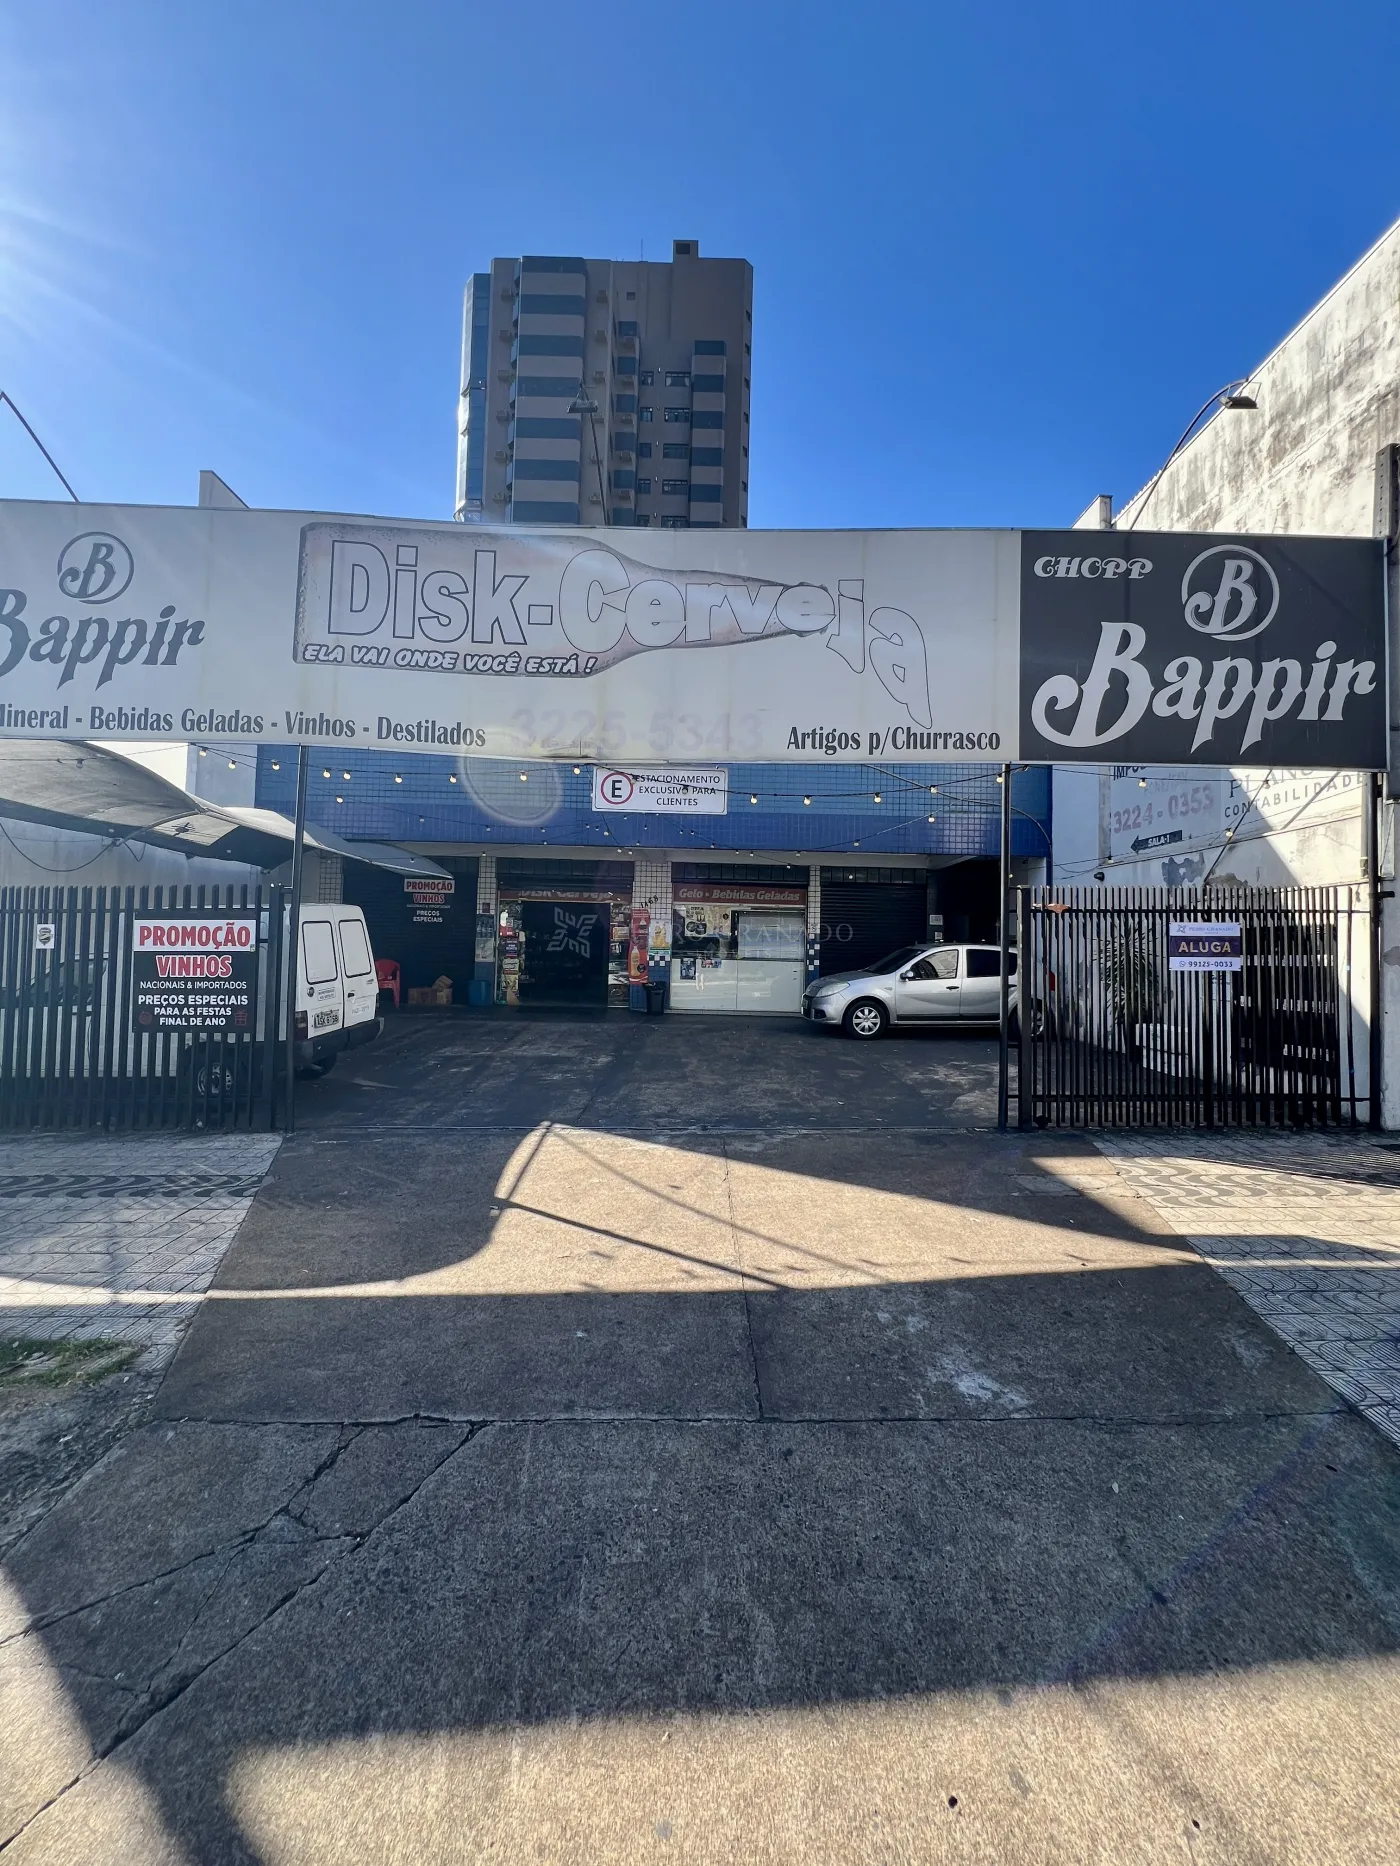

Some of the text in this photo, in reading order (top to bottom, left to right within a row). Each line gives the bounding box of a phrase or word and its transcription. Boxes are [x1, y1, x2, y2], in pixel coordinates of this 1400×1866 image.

[1033, 556, 1154, 580] CHOPP
[328, 539, 933, 729] Disk-Cerveja
[303, 644, 345, 663] ELA
[350, 646, 390, 665] VAI
[394, 648, 459, 669] ONDE
[463, 651, 522, 673] VOCÊ
[525, 653, 579, 675] ESTÁ
[1031, 621, 1376, 756] Bappir
[0, 703, 68, 729] ineral
[90, 706, 173, 732] Bebidas
[181, 708, 264, 733] Geladas
[285, 711, 356, 738] Vinhos
[377, 716, 486, 747] Destilados
[787, 726, 1000, 756] Artigos p/Churrasco
[635, 774, 721, 784] ESTACIONAMENTO
[611, 780, 622, 798] E
[692, 787, 716, 795] PARA
[656, 798, 698, 806] CLIENTES
[406, 881, 452, 891] PROMOÇÃO
[413, 893, 445, 903] VINHOS
[679, 888, 800, 901] Gelo Bebidas Geladas
[139, 922, 251, 949] PROMOÇÃO
[1178, 941, 1231, 953] ALUGA
[156, 954, 232, 978] VINHOS
[140, 981, 247, 990] NACIONAIS & IMPORTADOS
[138, 994, 248, 1007] PREÇOS ESPECIAIS
[154, 1007, 232, 1016] PARA AS FESTAS
[159, 1017, 226, 1025] FINAL DE ANO
